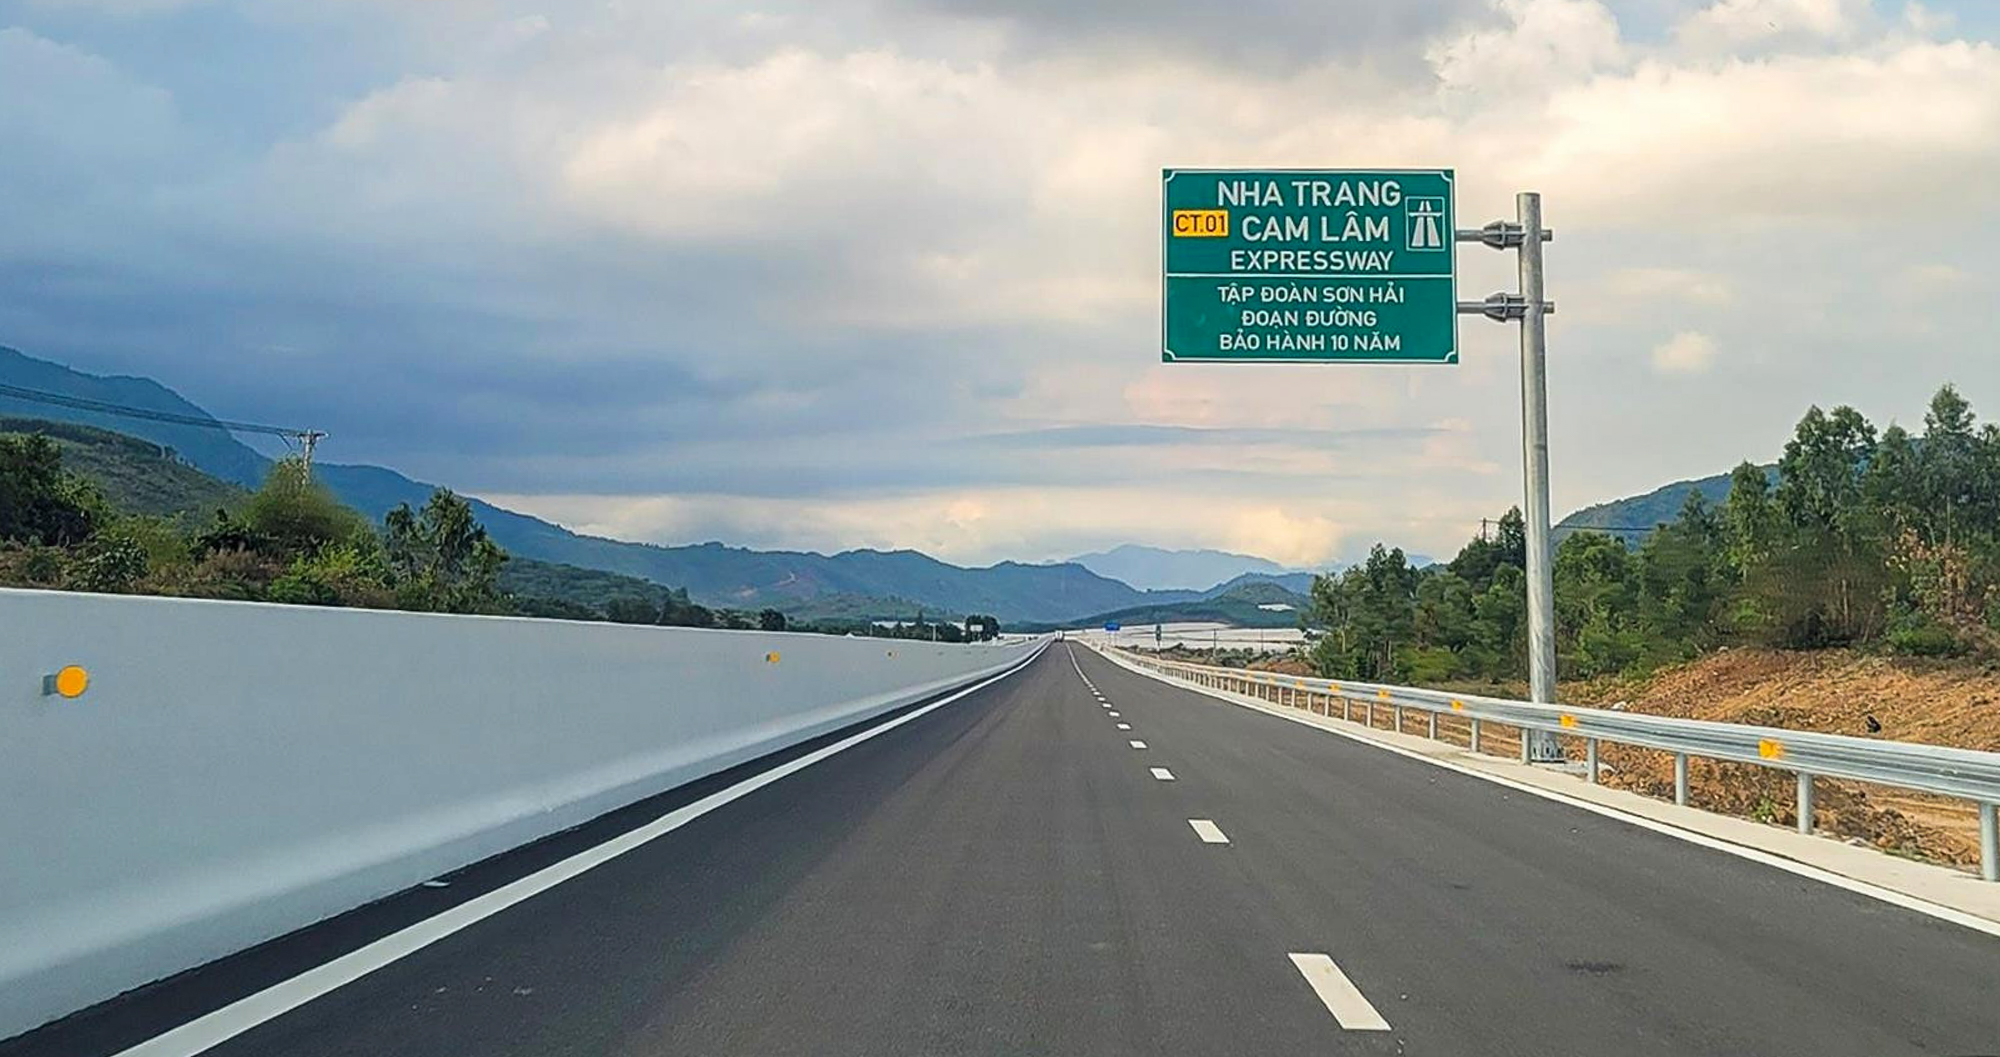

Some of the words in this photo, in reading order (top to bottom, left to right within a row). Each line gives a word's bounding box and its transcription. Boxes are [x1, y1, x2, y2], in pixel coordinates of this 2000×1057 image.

[1217, 181, 1283, 207] NHA
[1292, 181, 1401, 207] TRANG
[1175, 215, 1226, 233] CT.01
[1242, 216, 1309, 241] CAM
[1322, 211, 1389, 241] LÂM
[1231, 251, 1394, 270] EXPRESSWAY
[1217, 283, 1255, 306] TẬP
[1261, 282, 1317, 302] ĐOÀN
[1323, 286, 1365, 302] SƠN
[1370, 282, 1404, 302] HẢI
[1242, 311, 1298, 331] ĐOẠN
[1305, 307, 1377, 327] ĐƯỜNG
[1220, 329, 1259, 350] BẢO
[1266, 331, 1324, 350] HÀNH
[1331, 335, 1348, 350] 10
[1354, 331, 1401, 350] NĂM
